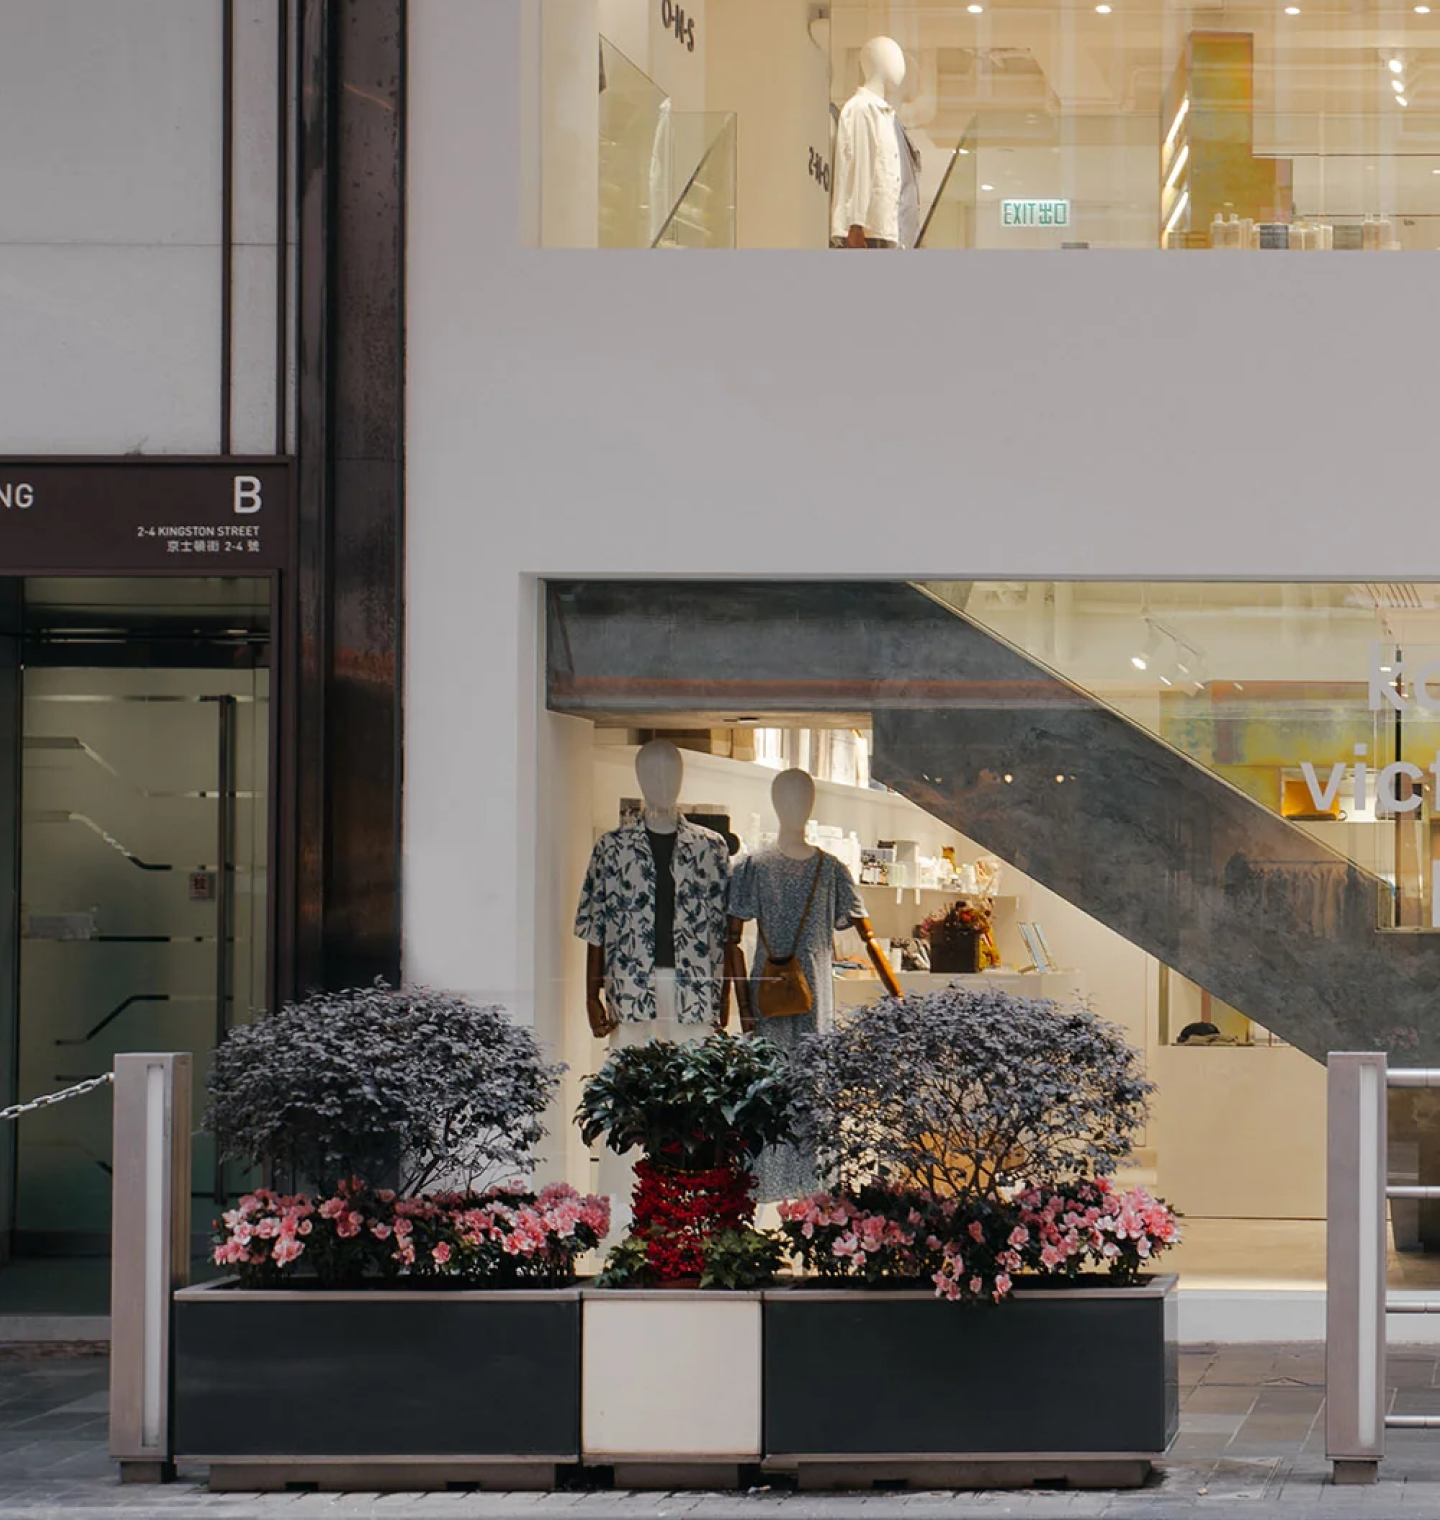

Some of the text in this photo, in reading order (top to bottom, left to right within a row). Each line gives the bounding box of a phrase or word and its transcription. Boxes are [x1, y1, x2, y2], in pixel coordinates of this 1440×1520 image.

[1004, 203, 1067, 225] EXIT 出口
[233, 475, 263, 514] B
[137, 525, 260, 537] 2-4 KINGSTON STREET
[224, 541, 244, 552] 2-4
